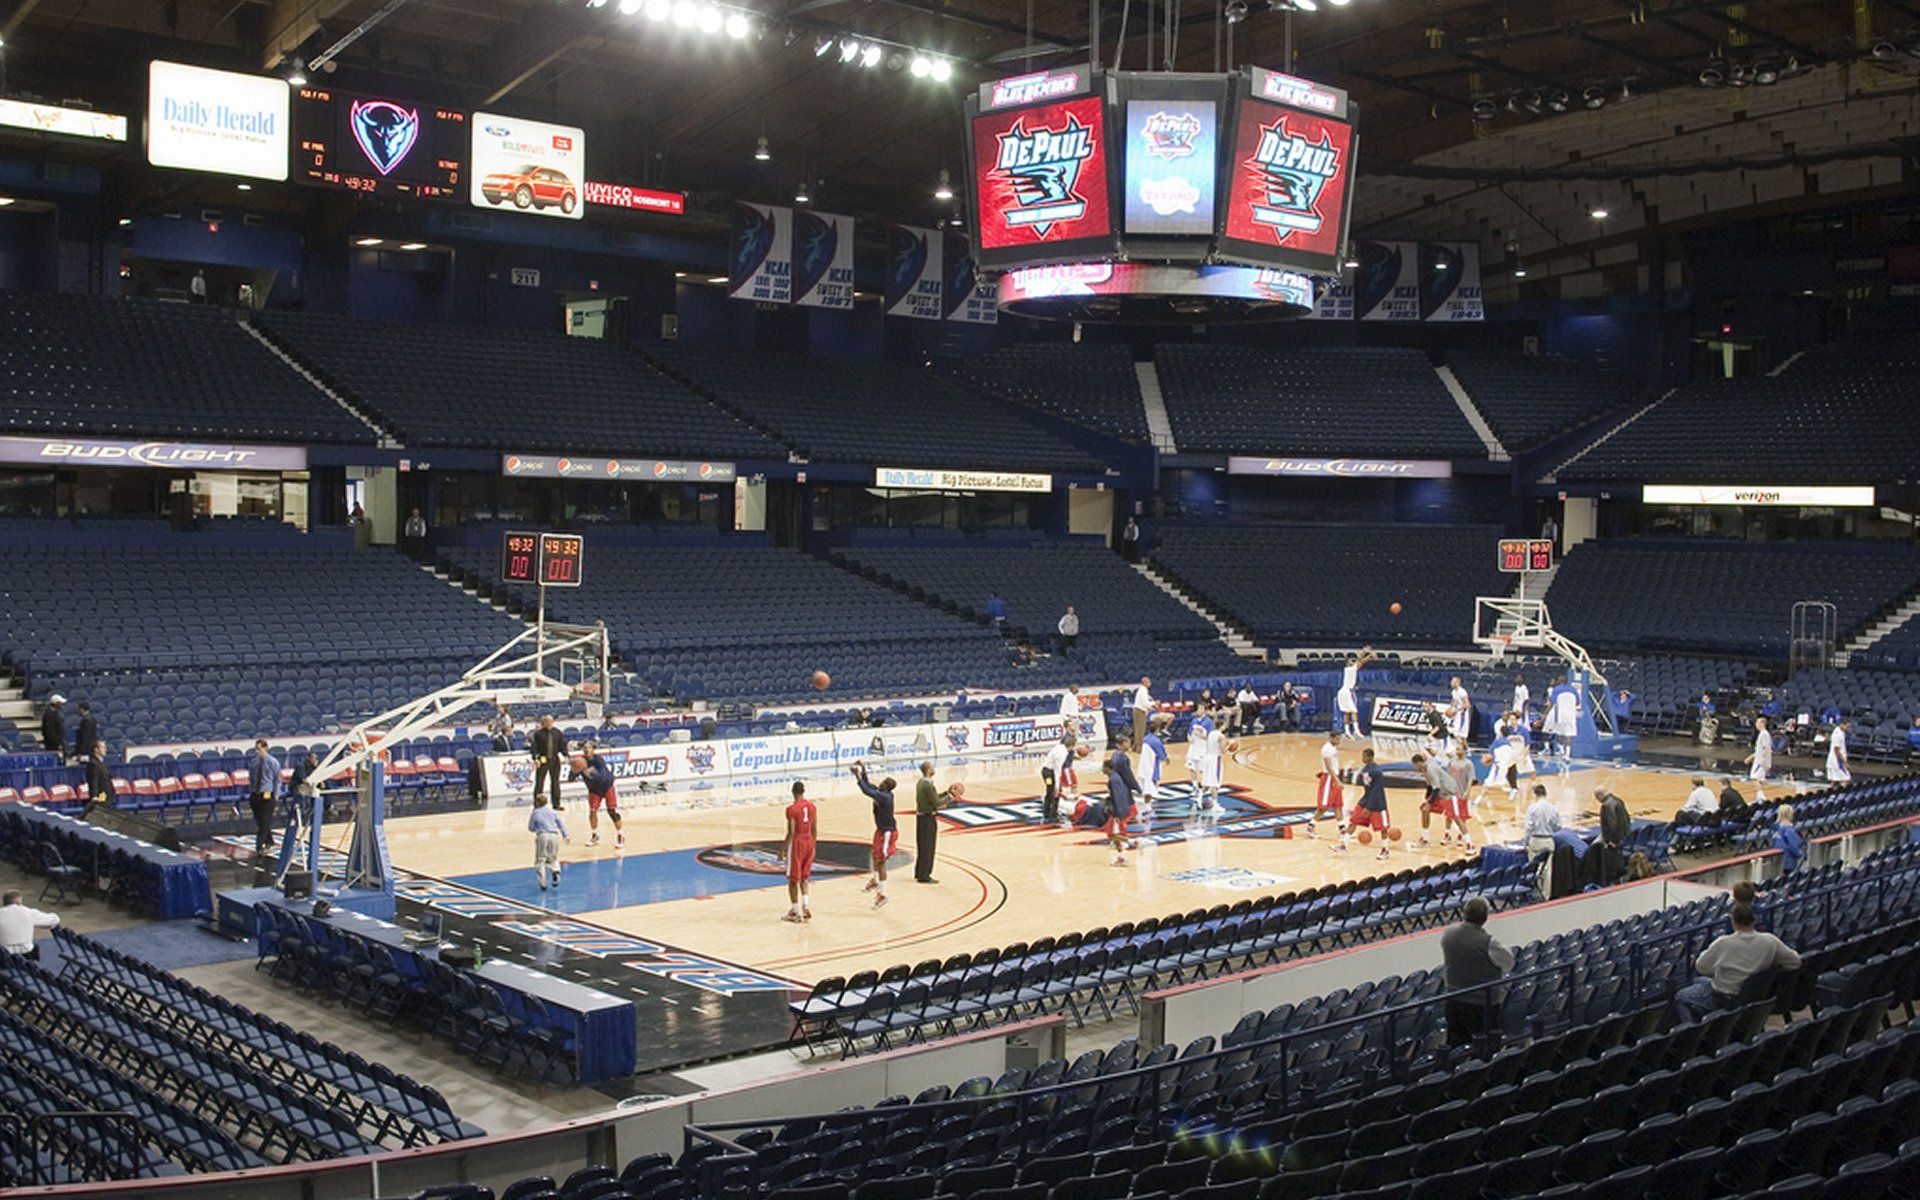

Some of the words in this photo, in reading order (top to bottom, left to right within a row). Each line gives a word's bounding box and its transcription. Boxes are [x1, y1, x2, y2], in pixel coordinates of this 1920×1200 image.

[164, 96, 209, 127] Daily
[216, 104, 275, 135] Herald
[345, 177, 377, 192] 49:32
[828, 267, 853, 282] NCAA
[919, 280, 940, 294] NCAA
[41, 443, 127, 458] BUD
[147, 447, 256, 462] LIGHT
[521, 461, 544, 471] pepsi
[572, 463, 593, 472] pepsi
[620, 464, 641, 473] pepsi
[667, 466, 687, 475] pepsi
[712, 467, 731, 476] pepsi
[1265, 460, 1322, 471] BUD
[1336, 461, 1413, 473] LIGHT
[885, 471, 906, 485] Daily
[907, 471, 934, 485] Herald
[942, 473, 957, 487] Big
[1021, 477, 1044, 489] Focus
[1735, 491, 1780, 503] verizon
[509, 537, 534, 552] 49:32
[545, 540, 578, 555] 49:32
[511, 556, 529, 577] 00
[548, 558, 572, 580] 00
[803, 806, 809, 823] 1
